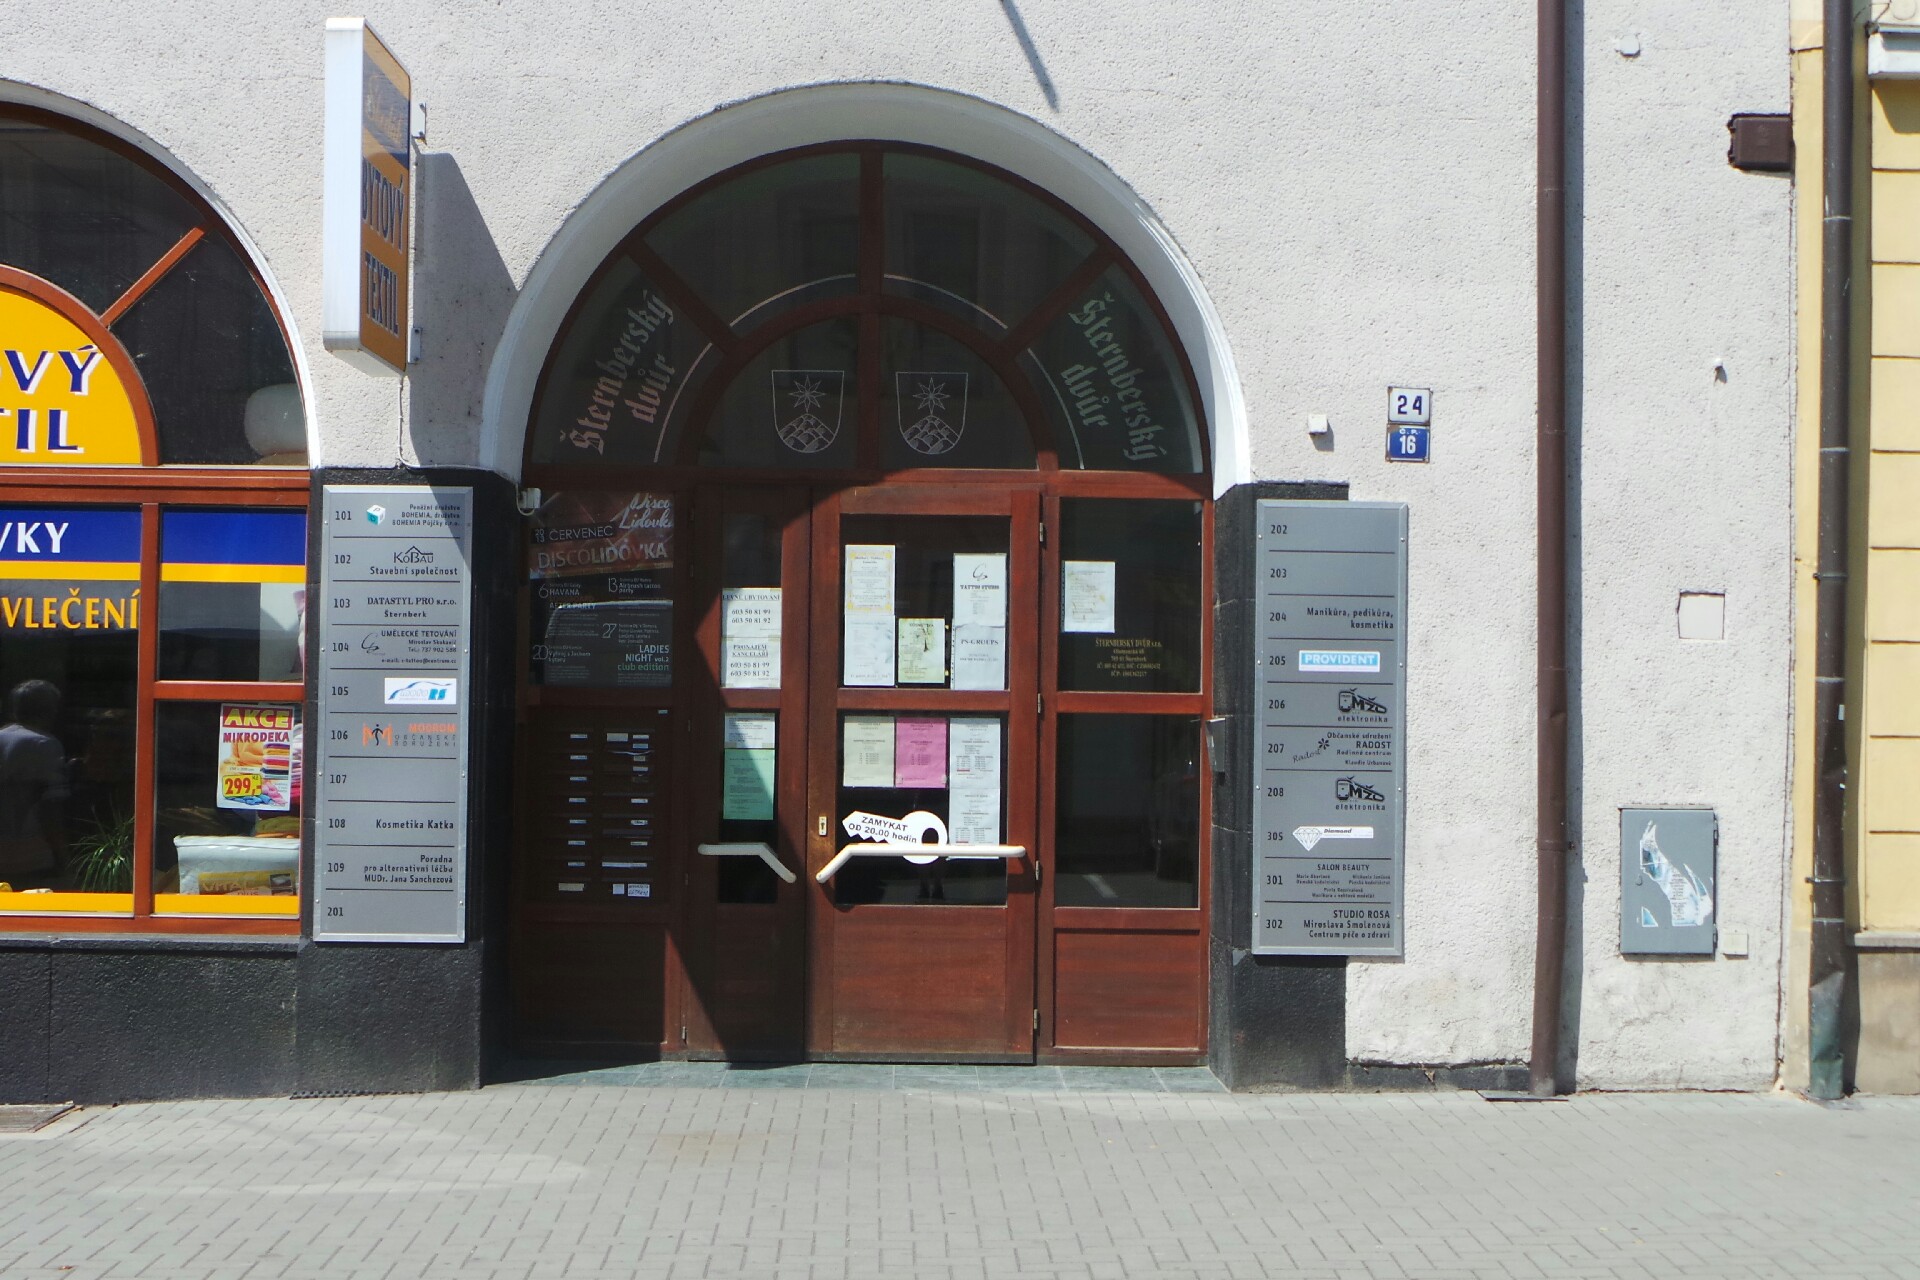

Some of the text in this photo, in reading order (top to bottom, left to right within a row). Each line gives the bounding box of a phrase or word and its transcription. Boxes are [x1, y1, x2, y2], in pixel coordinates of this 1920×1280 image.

[365, 251, 400, 335] TEXTIL
[0, 345, 103, 395] VÝ
[1398, 395, 1422, 415] 24
[1400, 435, 1416, 454] 16
[335, 511, 352, 521] 101
[549, 525, 614, 541] ČERVENEC
[1271, 525, 1288, 534] 202
[335, 554, 351, 564] 102
[370, 566, 458, 576] Stavební společnost
[1270, 569, 1287, 578] 203
[333, 599, 351, 608] 103
[367, 597, 413, 605] DATASTYL
[384, 610, 427, 618] Šternberk
[1270, 612, 1287, 622] 204
[1350, 619, 1394, 629] kosmetika
[332, 642, 349, 652] 104
[639, 644, 670, 654] LADIES
[625, 653, 653, 662] NIGHT
[1269, 656, 1286, 666] 205
[1304, 654, 1375, 664] PROVIDENT
[617, 663, 669, 671] club edition
[332, 686, 349, 696] 105
[1268, 699, 1285, 709] 206
[224, 708, 290, 728] AKCE
[223, 732, 290, 743] MIKRODEKA
[331, 730, 348, 740] 106
[1268, 743, 1285, 753] 207
[1356, 741, 1392, 749] RADOST
[330, 774, 347, 784] 107
[1267, 787, 1284, 797] 208
[1335, 803, 1386, 811] elektronika
[328, 818, 346, 829] 108
[376, 819, 454, 829] Kosmetika Katka
[861, 816, 908, 832] ZAMYKAT
[848, 823, 917, 844] OD 20.00 hodin
[1267, 832, 1284, 841] 305
[420, 854, 453, 863] Poradna
[327, 862, 345, 873] 109
[379, 864, 429, 872] alternativní
[1317, 863, 1340, 871] SALON
[390, 875, 407, 883] Jana
[1266, 875, 1283, 885] 301
[327, 907, 344, 916] 201
[1333, 910, 1390, 919] STUDIO ROSA
[1265, 920, 1283, 929] 302
[1303, 919, 1391, 929] Miroslava Smolenová
[1309, 930, 1340, 938] Centrum
[1367, 931, 1390, 939] zdraví
